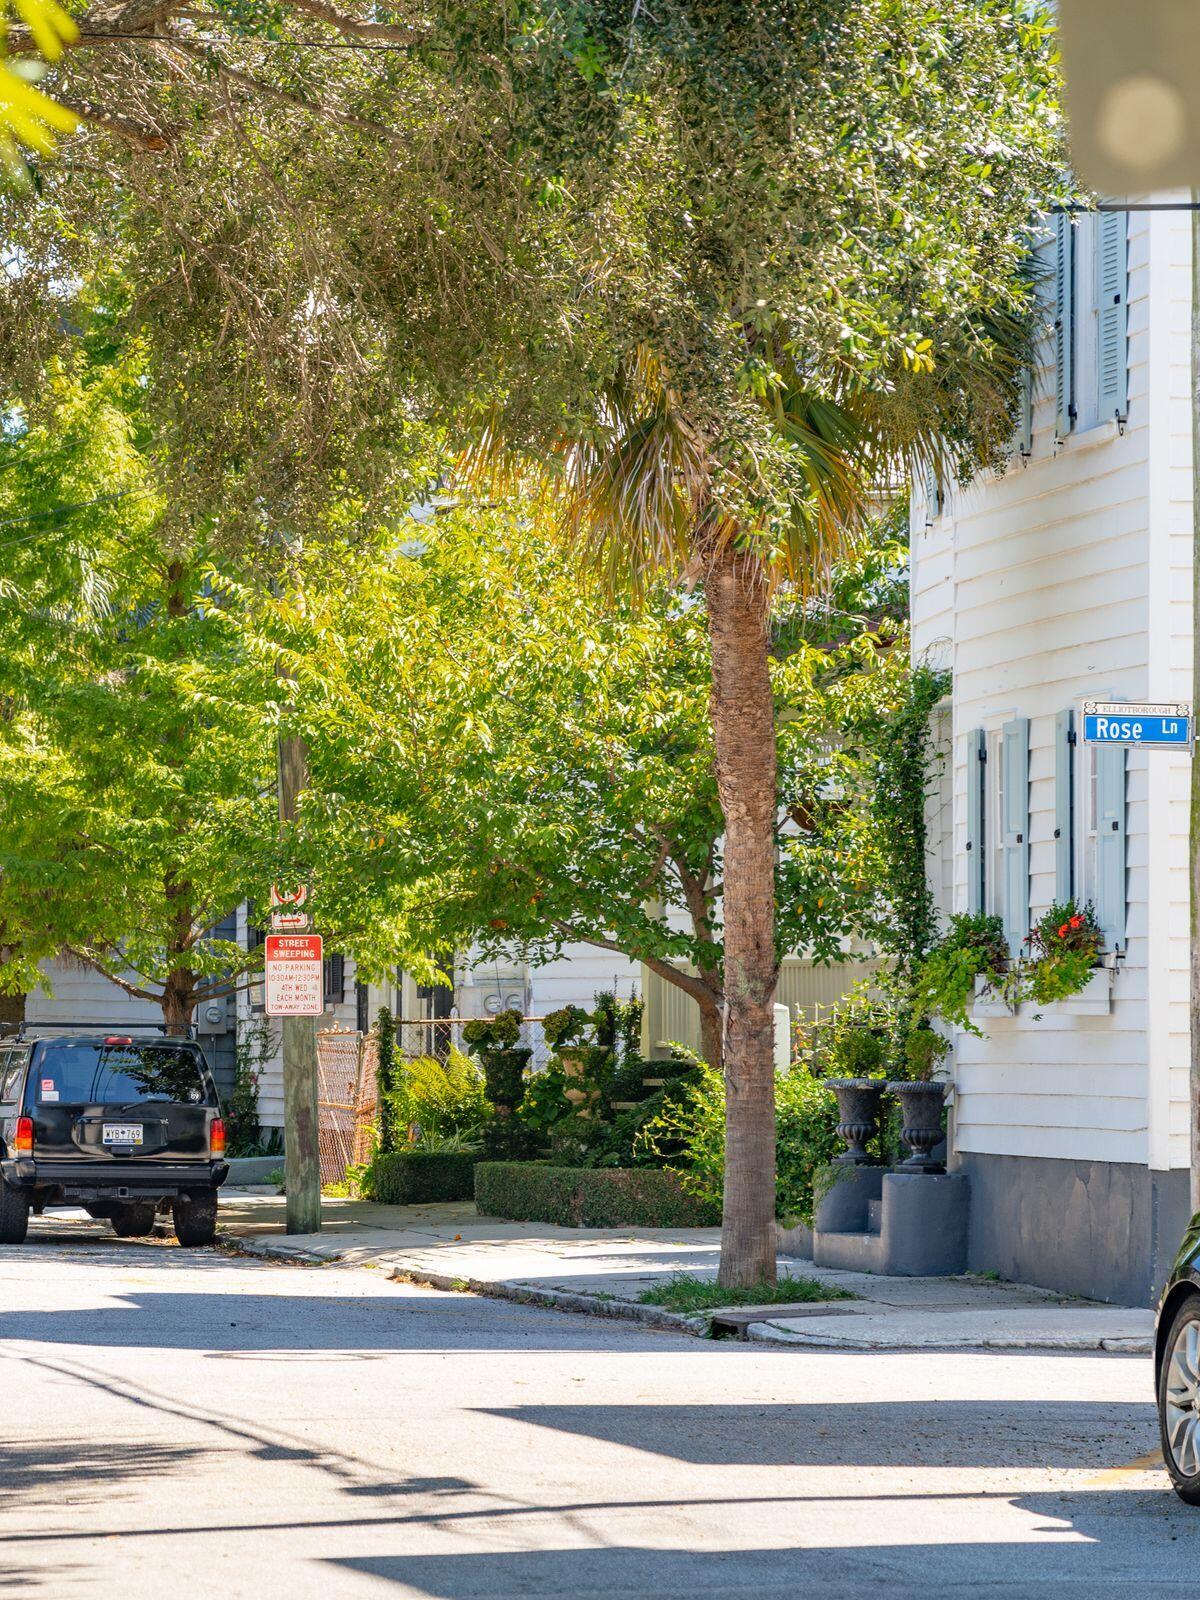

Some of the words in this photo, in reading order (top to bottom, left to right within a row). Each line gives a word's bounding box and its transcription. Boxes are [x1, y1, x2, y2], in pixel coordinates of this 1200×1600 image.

[1097, 718, 1143, 739] Rose
[1162, 719, 1178, 734] Ln
[278, 939, 309, 947] STREET
[273, 949, 315, 958] SWEEPING
[276, 994, 293, 1002] EACH
[295, 994, 316, 1002] MONTH
[126, 1129, 141, 1139] 769
